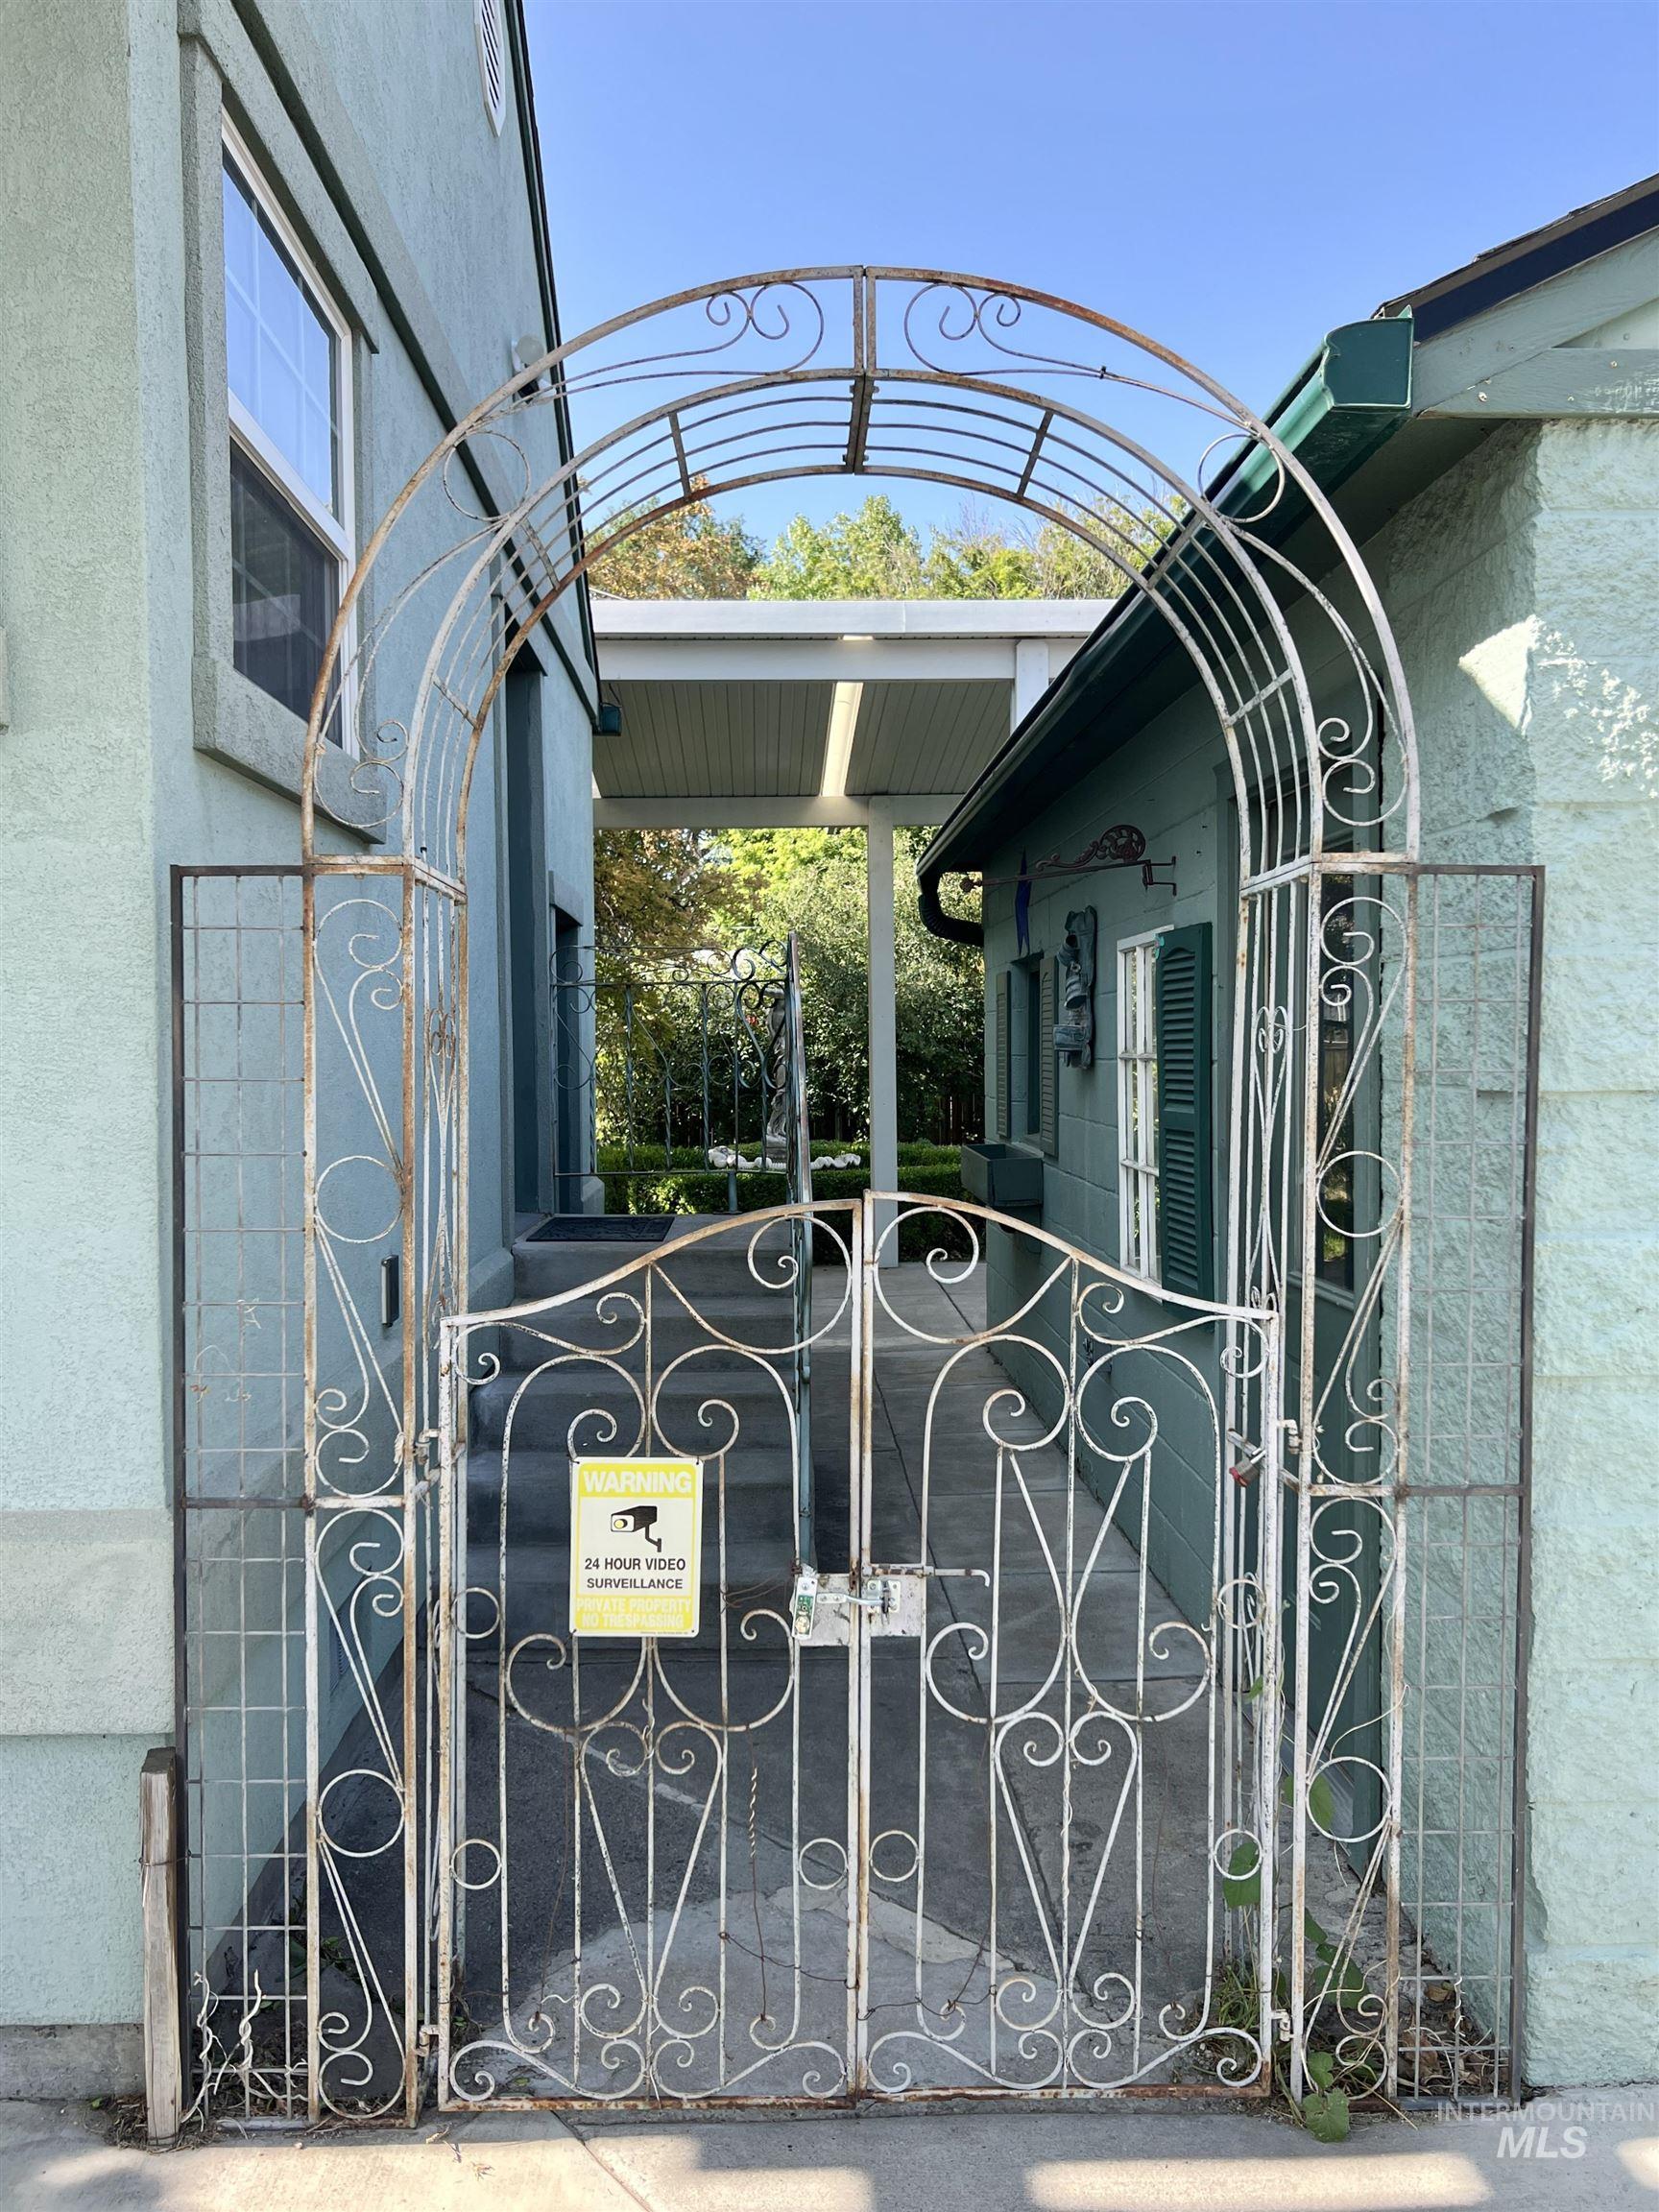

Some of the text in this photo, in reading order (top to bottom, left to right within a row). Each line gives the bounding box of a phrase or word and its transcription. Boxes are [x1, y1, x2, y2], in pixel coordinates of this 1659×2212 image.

[583, 1471, 692, 1494] WARNING
[585, 1557, 686, 1571] 24 HOUR VIDEO
[587, 1577, 684, 1590] SURVEILLANCE
[576, 1597, 691, 1613] PRIVATE PROPERTY
[583, 1613, 684, 1628] NO TRESPASSING
